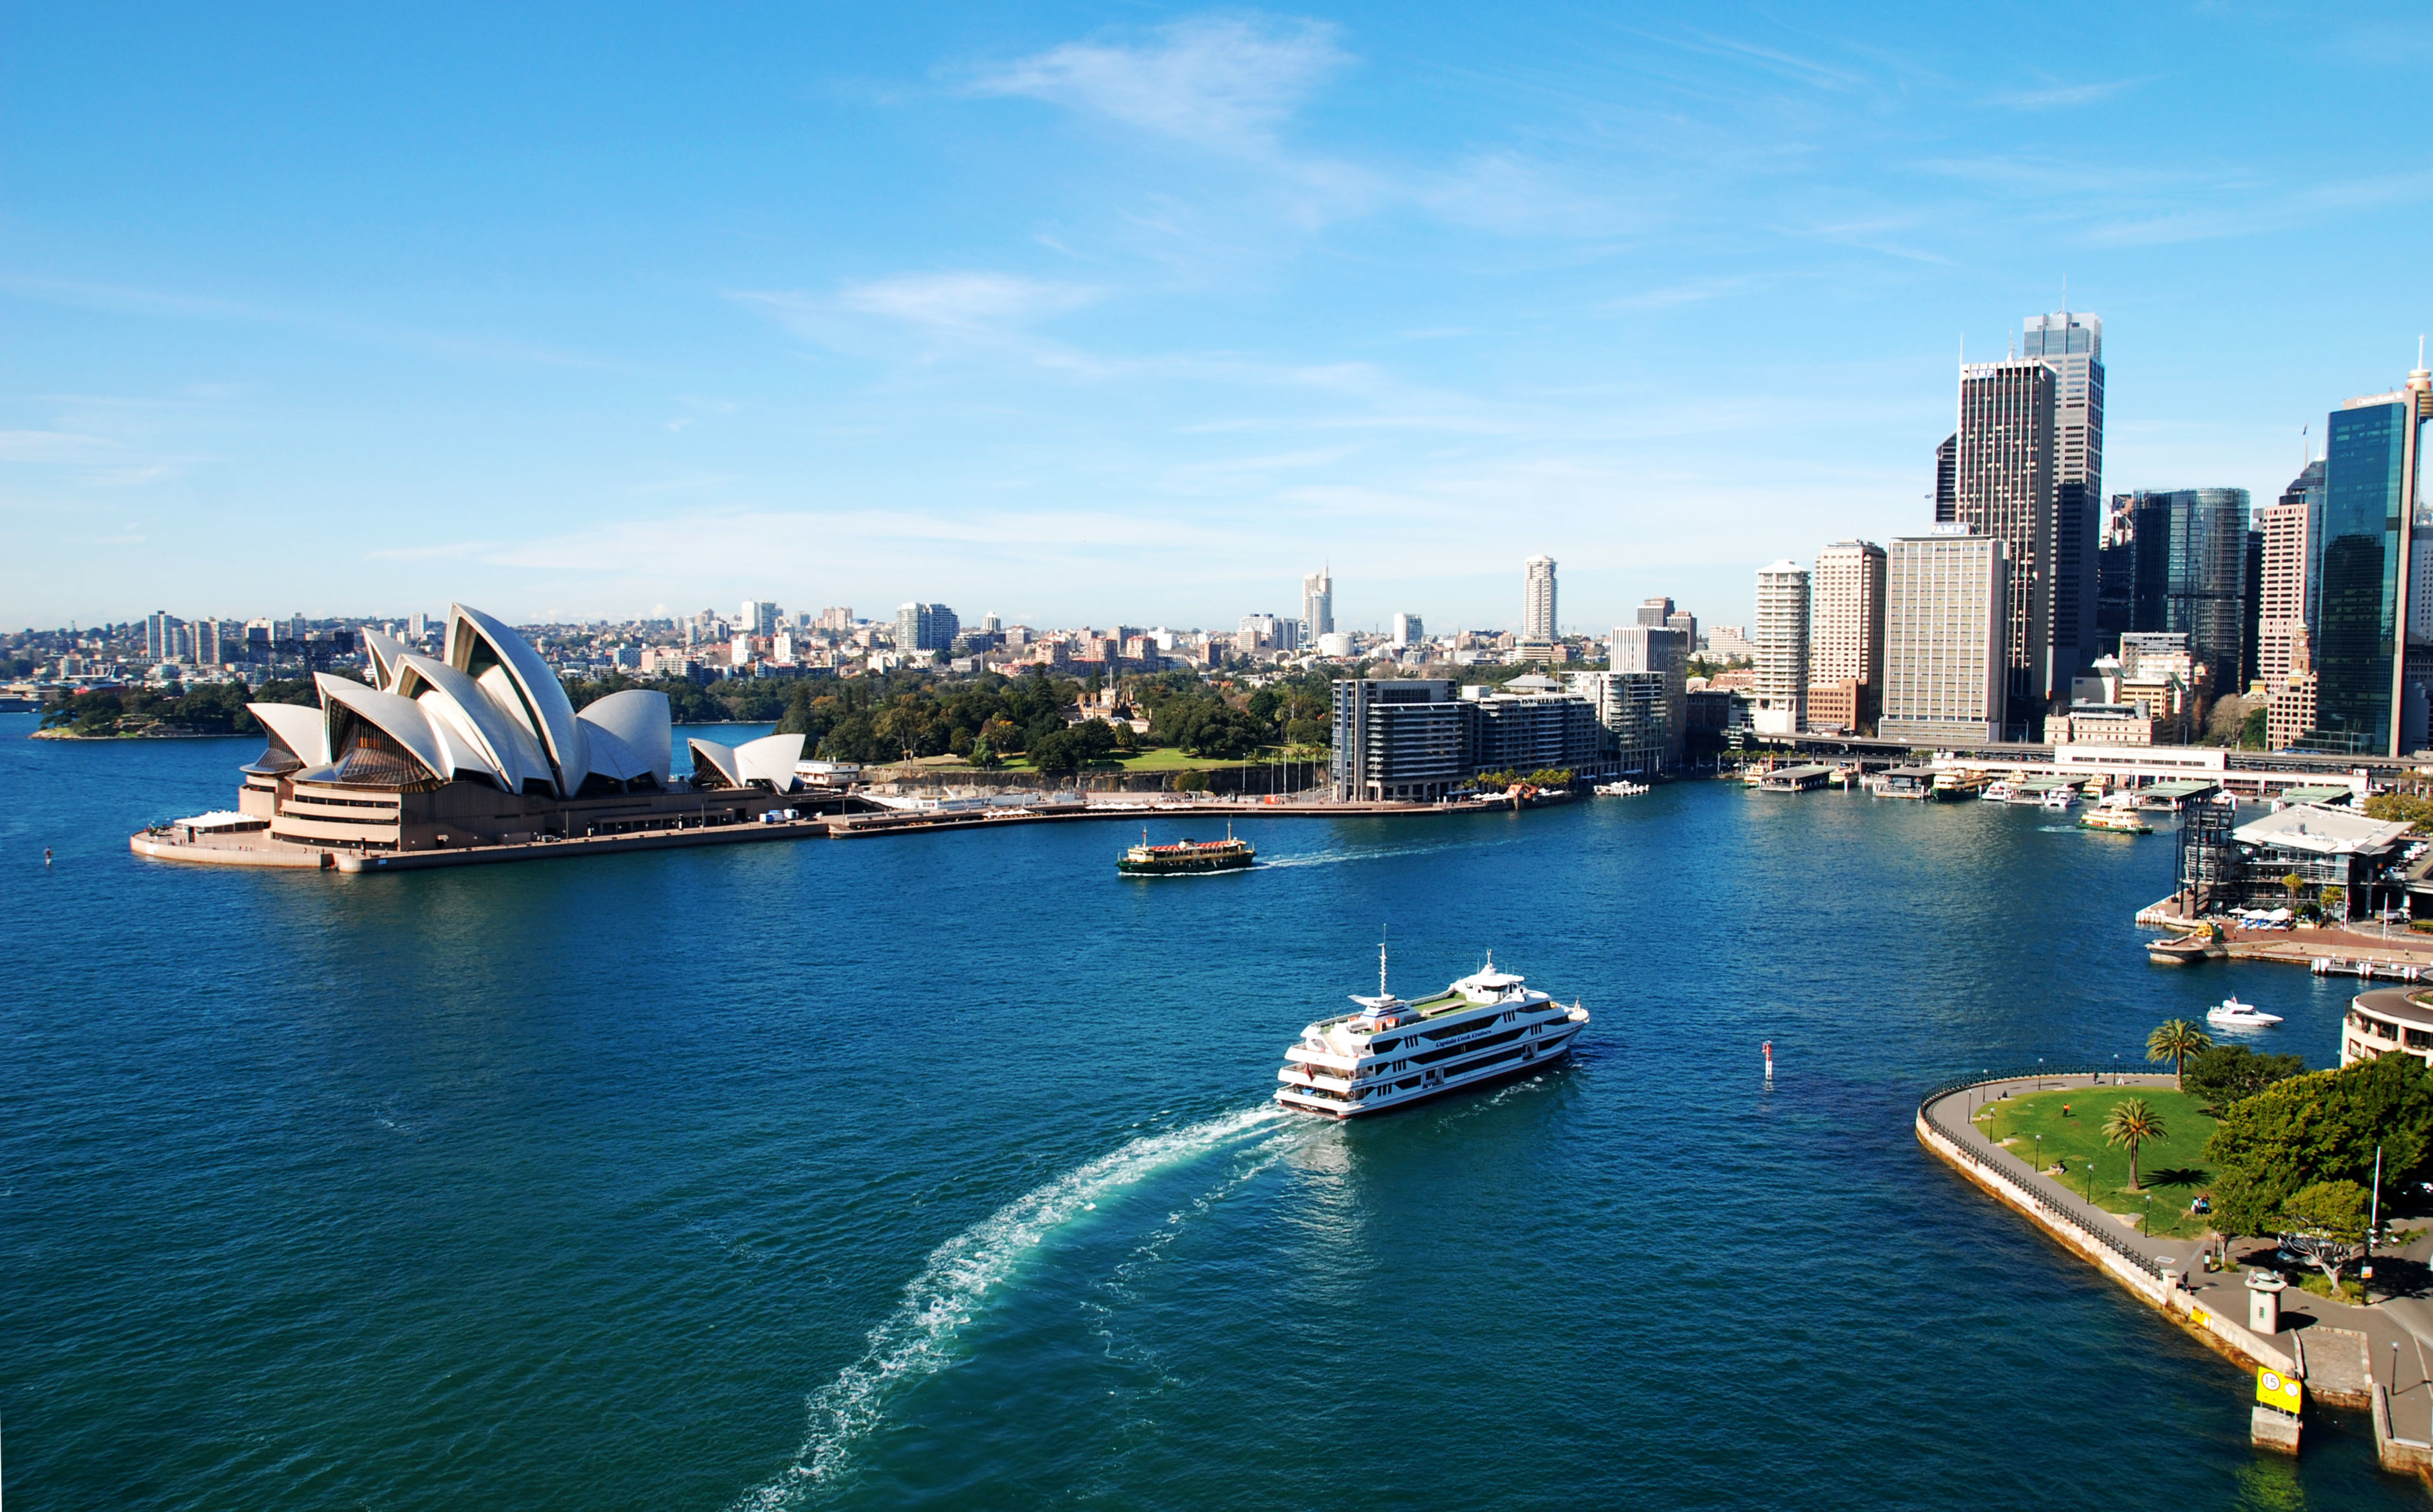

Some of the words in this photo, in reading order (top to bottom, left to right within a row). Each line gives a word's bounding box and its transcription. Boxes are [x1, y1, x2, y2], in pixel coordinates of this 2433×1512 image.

[1972, 369, 1994, 378] AMP
[1935, 524, 1964, 534] AMP
[1436, 1038, 1457, 1047] Captain
[2266, 1376, 2277, 1387] 15
